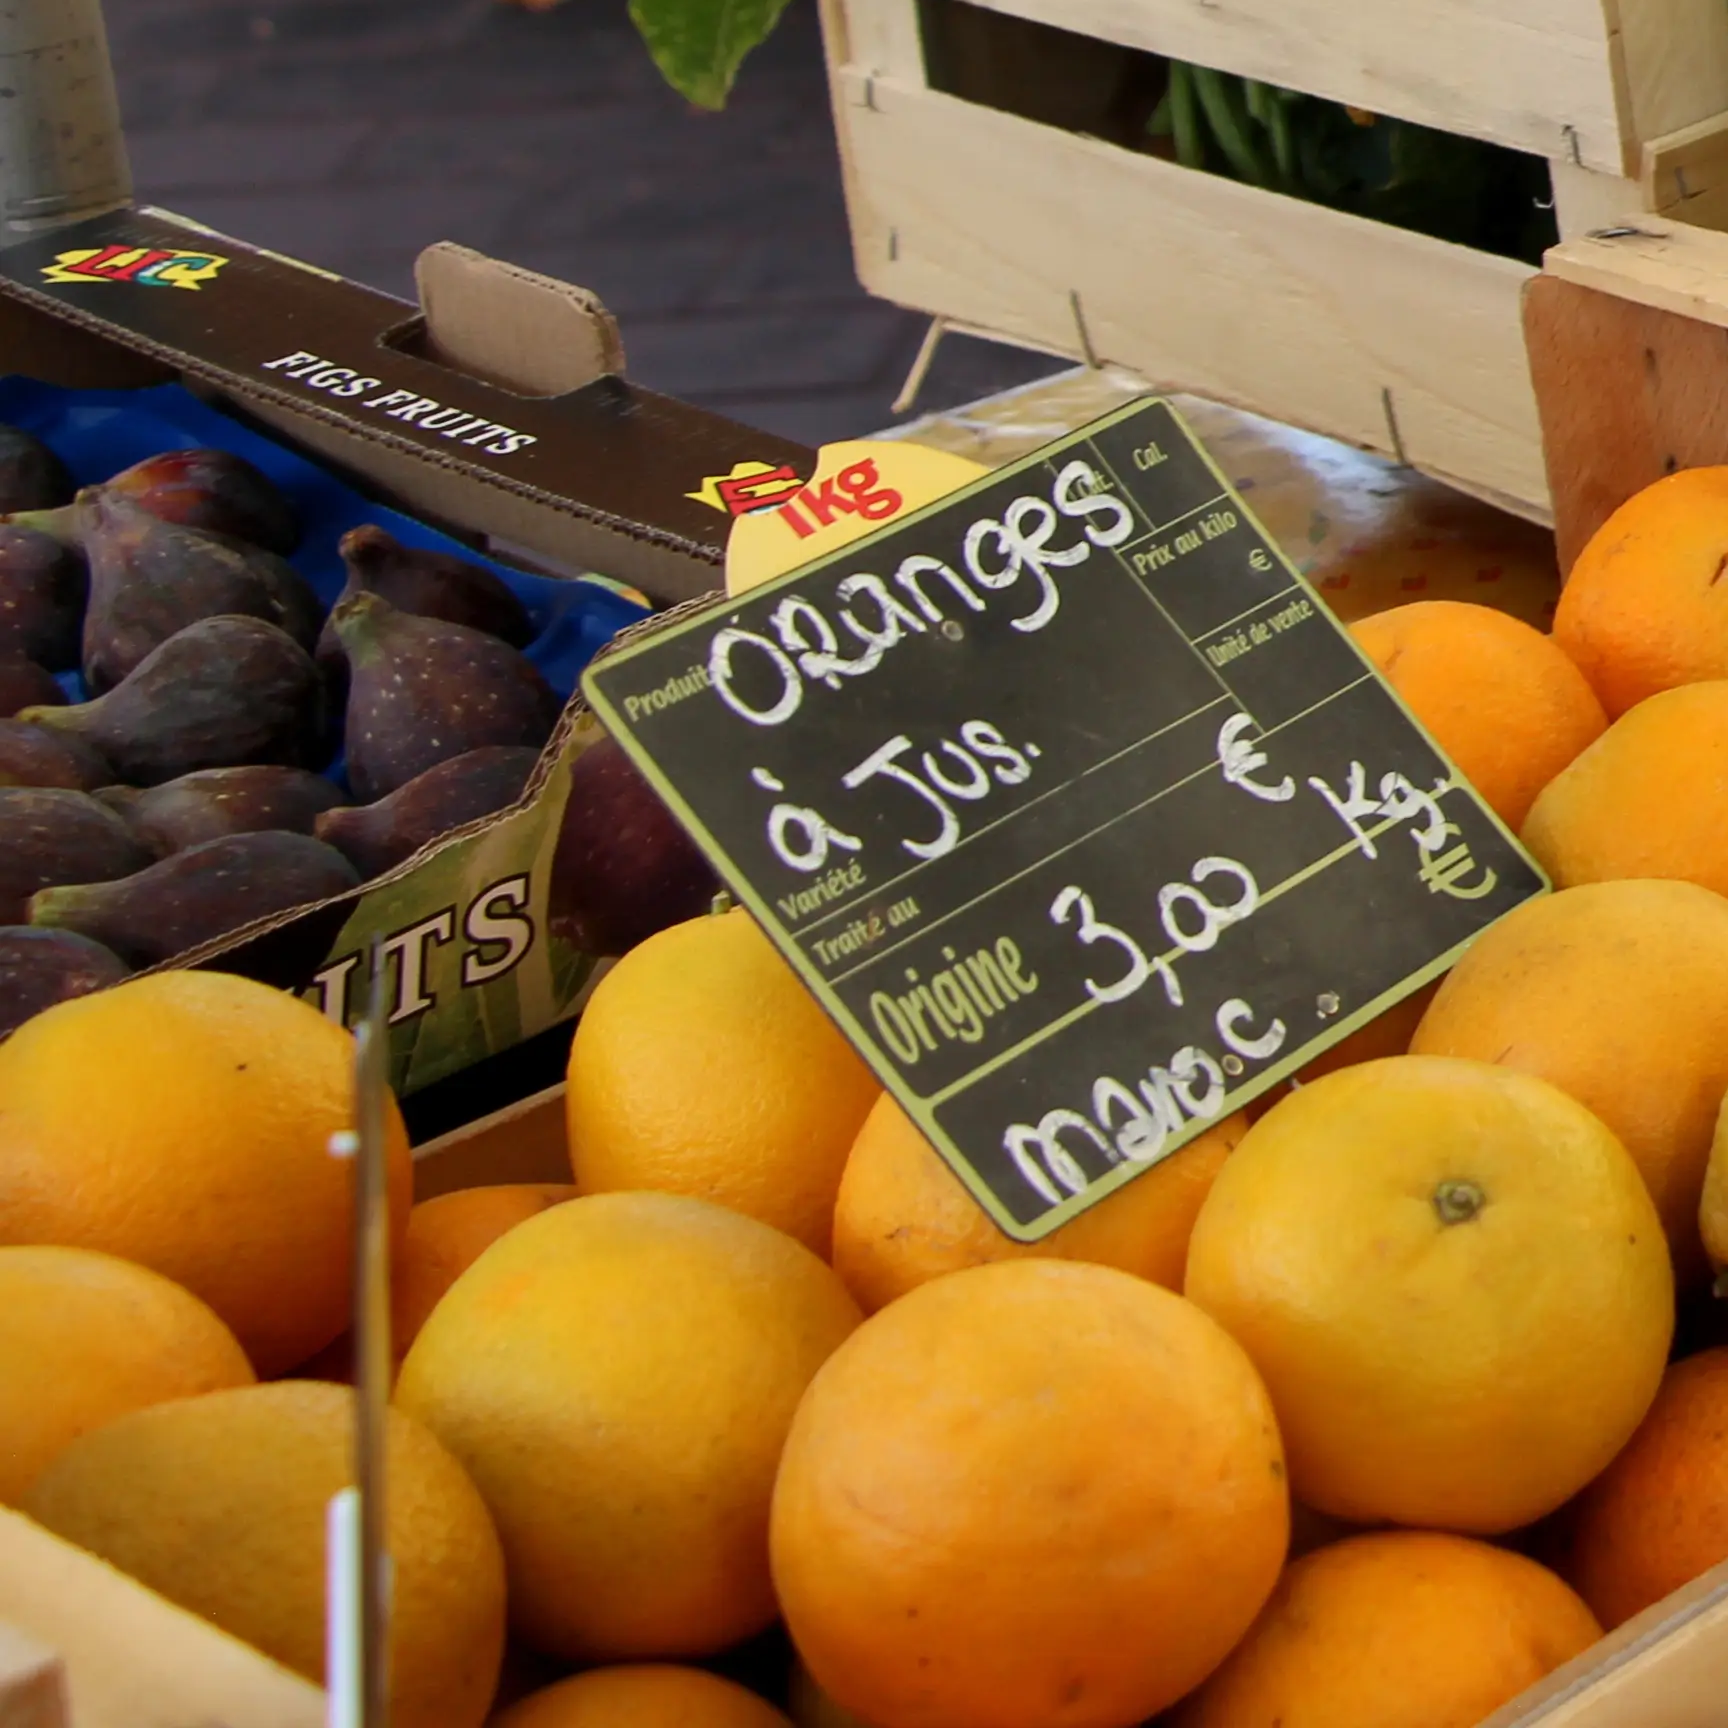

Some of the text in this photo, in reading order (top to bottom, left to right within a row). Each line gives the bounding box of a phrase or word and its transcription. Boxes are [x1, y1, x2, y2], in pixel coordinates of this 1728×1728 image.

[262, 350, 538, 455] FIGS FRUITS
[1132, 441, 1169, 471] Cal.
[777, 457, 904, 540] 1kg
[1132, 510, 1238, 575] Prix au kilo
[1249, 548, 1273, 571] €
[1205, 597, 1315, 668] Unité de vente
[622, 663, 716, 723] Produit
[1217, 712, 1296, 801] €
[777, 857, 868, 922] Variété
[811, 894, 921, 968] Traité au
[1049, 856, 1260, 1007] 3,00
[868, 935, 1039, 1065] Origine
